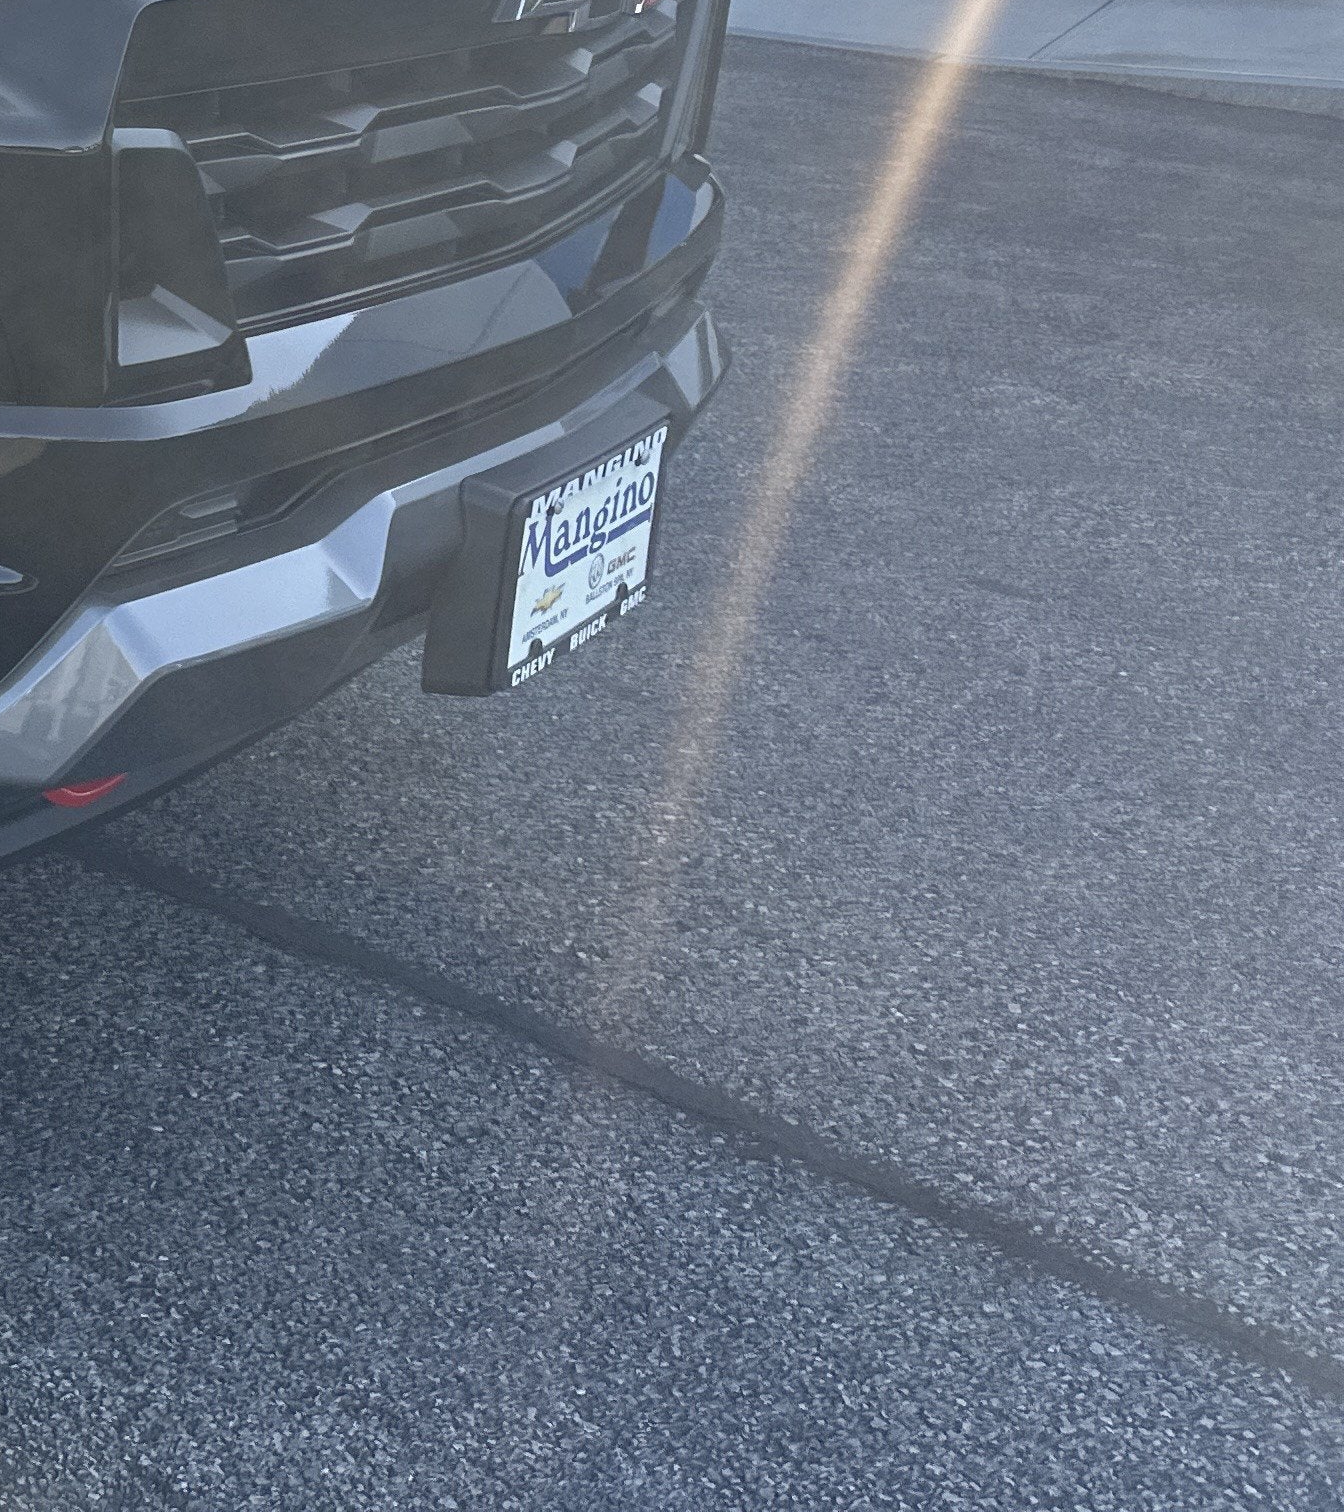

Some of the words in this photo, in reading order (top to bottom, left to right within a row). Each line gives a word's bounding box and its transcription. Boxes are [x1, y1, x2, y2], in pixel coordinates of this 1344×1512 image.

[529, 426, 668, 519] MANGINO
[518, 471, 655, 577] Mangino
[607, 546, 637, 576] GMC
[511, 648, 556, 687] CHEVY
[569, 614, 608, 651] BUICK
[620, 586, 647, 615] GMC
